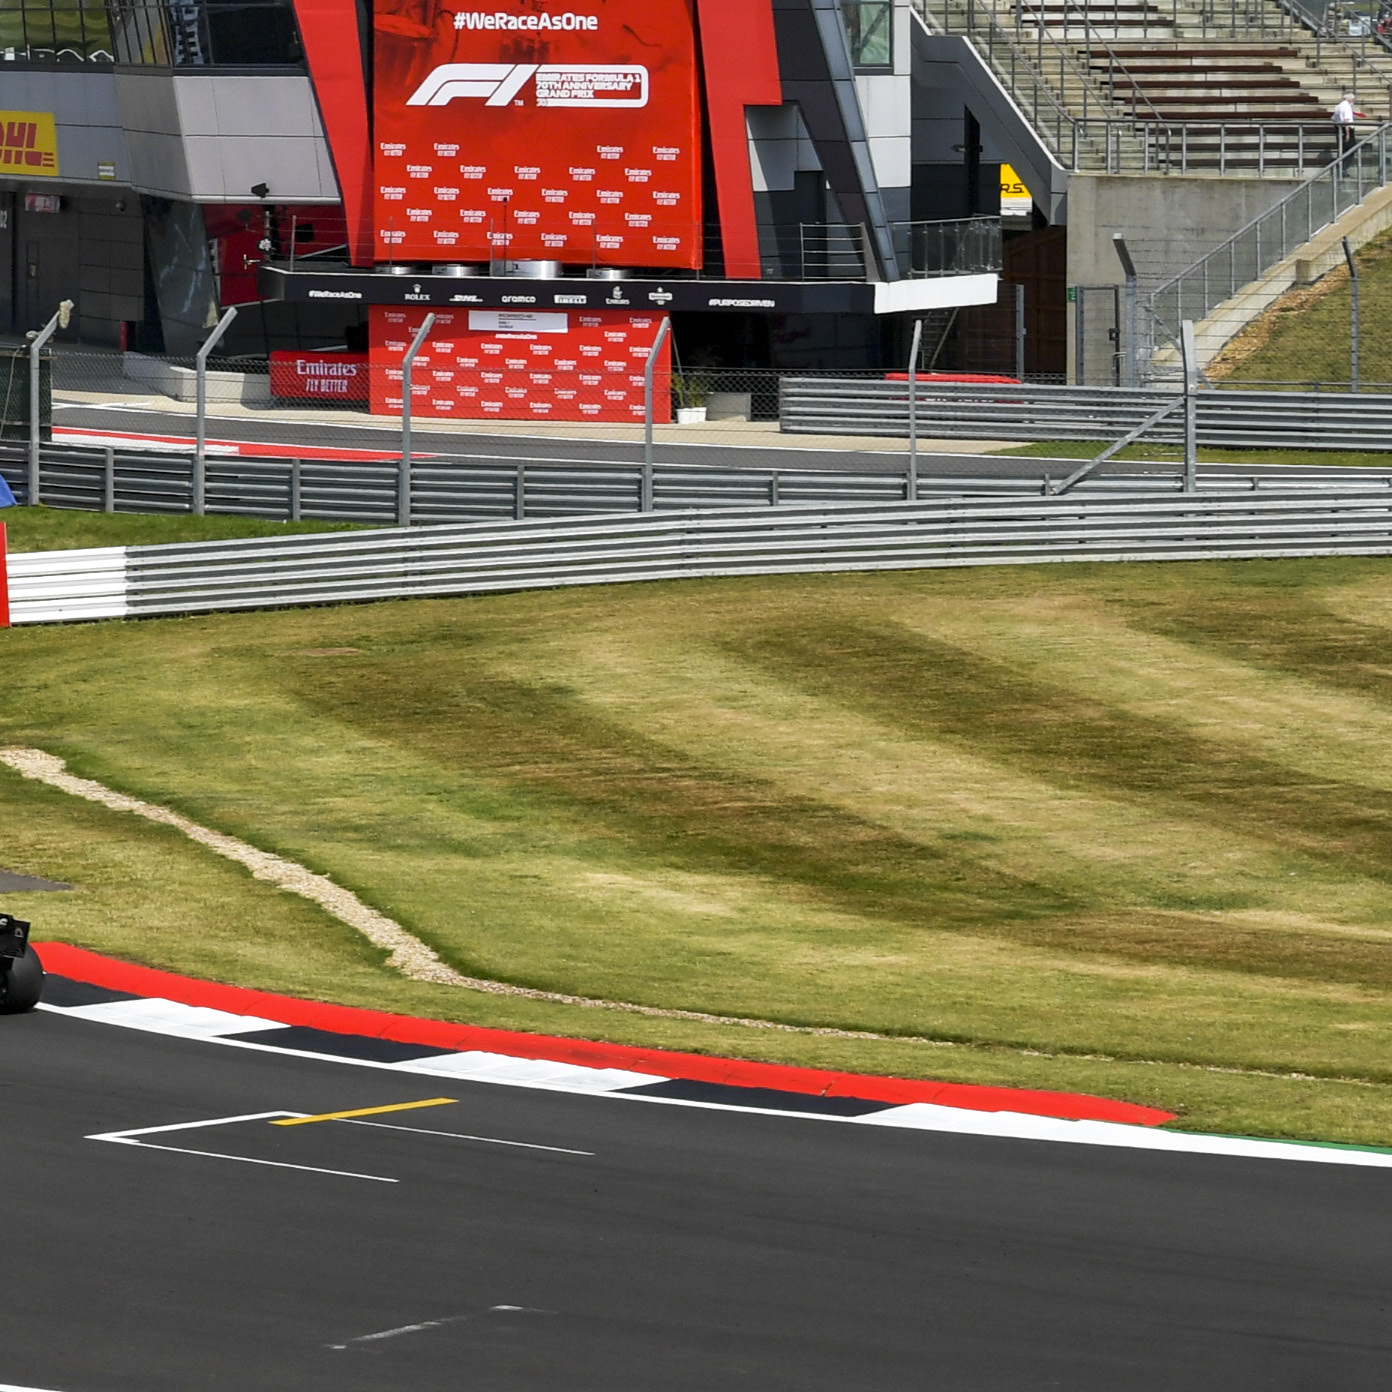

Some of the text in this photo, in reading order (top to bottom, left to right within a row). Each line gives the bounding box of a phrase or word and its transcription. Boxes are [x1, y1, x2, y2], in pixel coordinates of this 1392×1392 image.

[453, 11, 599, 31] #WeRaceAsOne
[404, 293, 431, 301] ROLEX
[501, 295, 536, 303] aramco
[297, 359, 357, 376] Emirates
